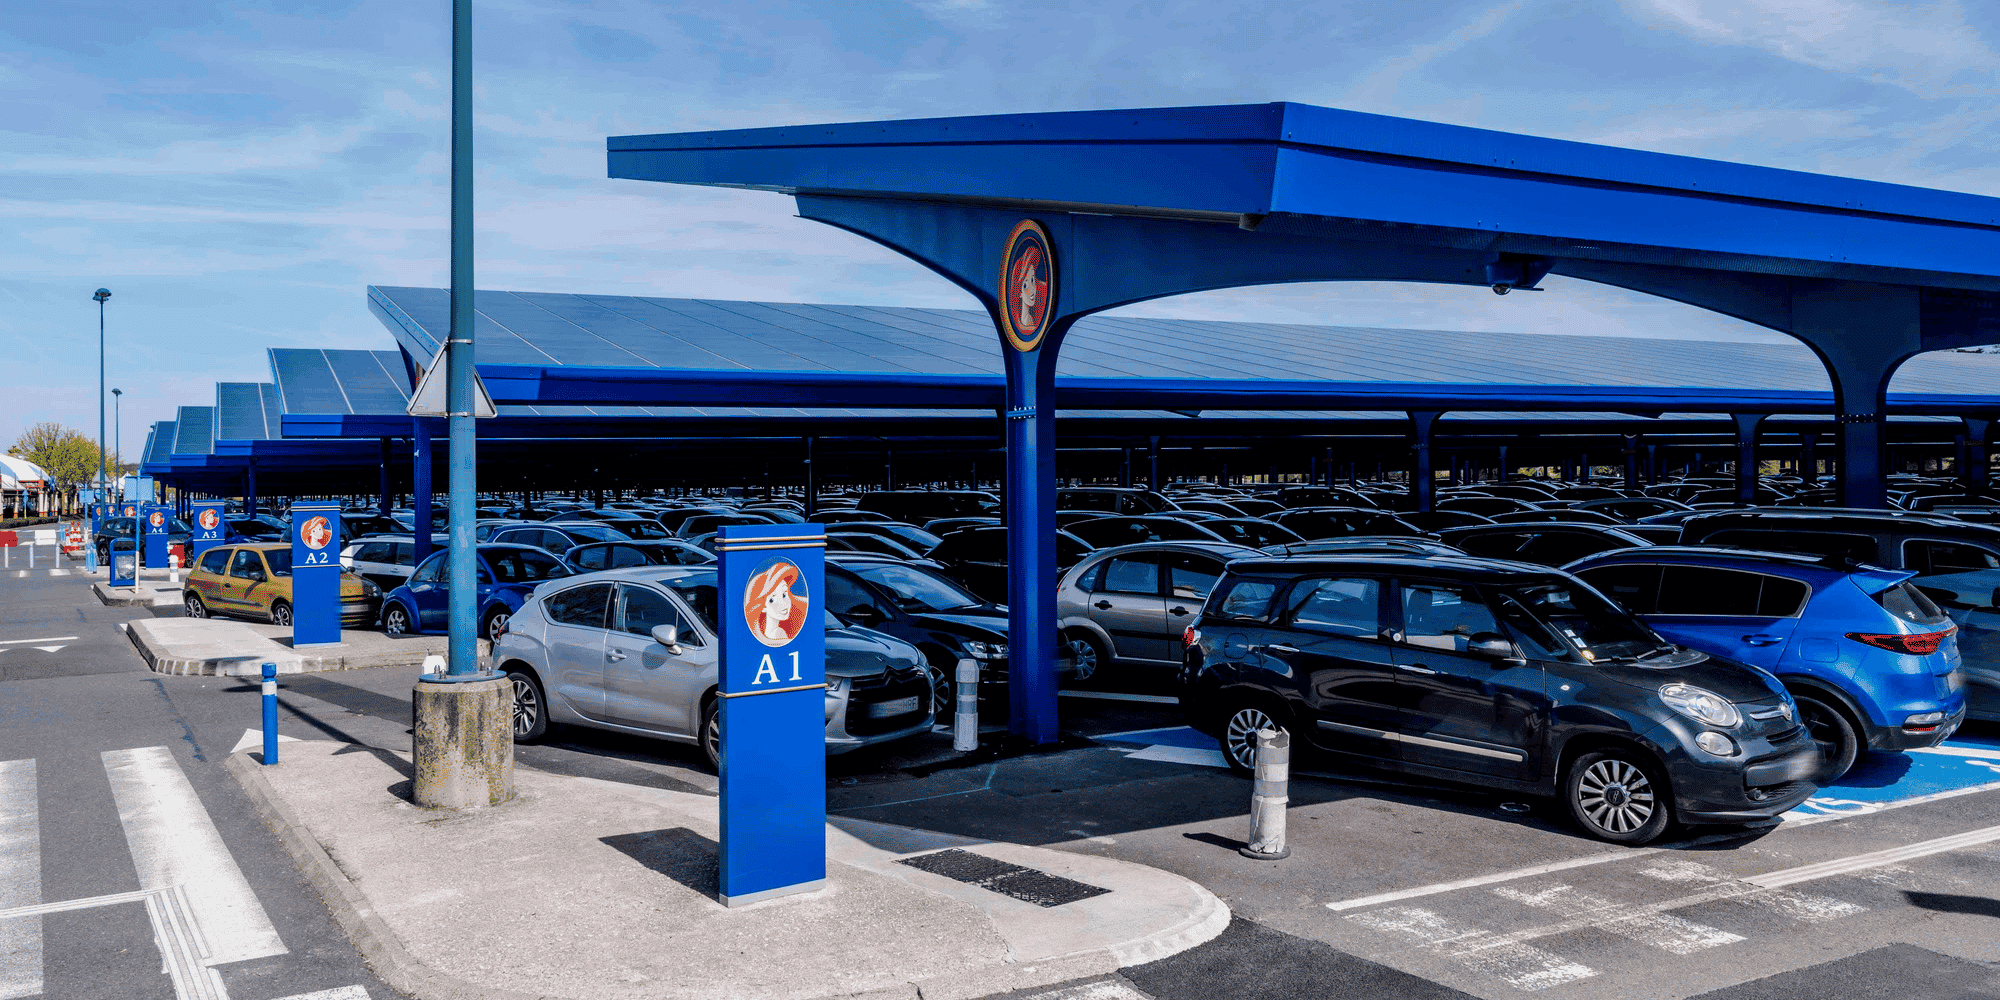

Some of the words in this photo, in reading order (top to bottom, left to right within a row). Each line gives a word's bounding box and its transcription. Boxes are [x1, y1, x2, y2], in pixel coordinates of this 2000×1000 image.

[202, 531, 217, 539] A3
[305, 552, 329, 564] A2
[751, 651, 803, 685] A1
